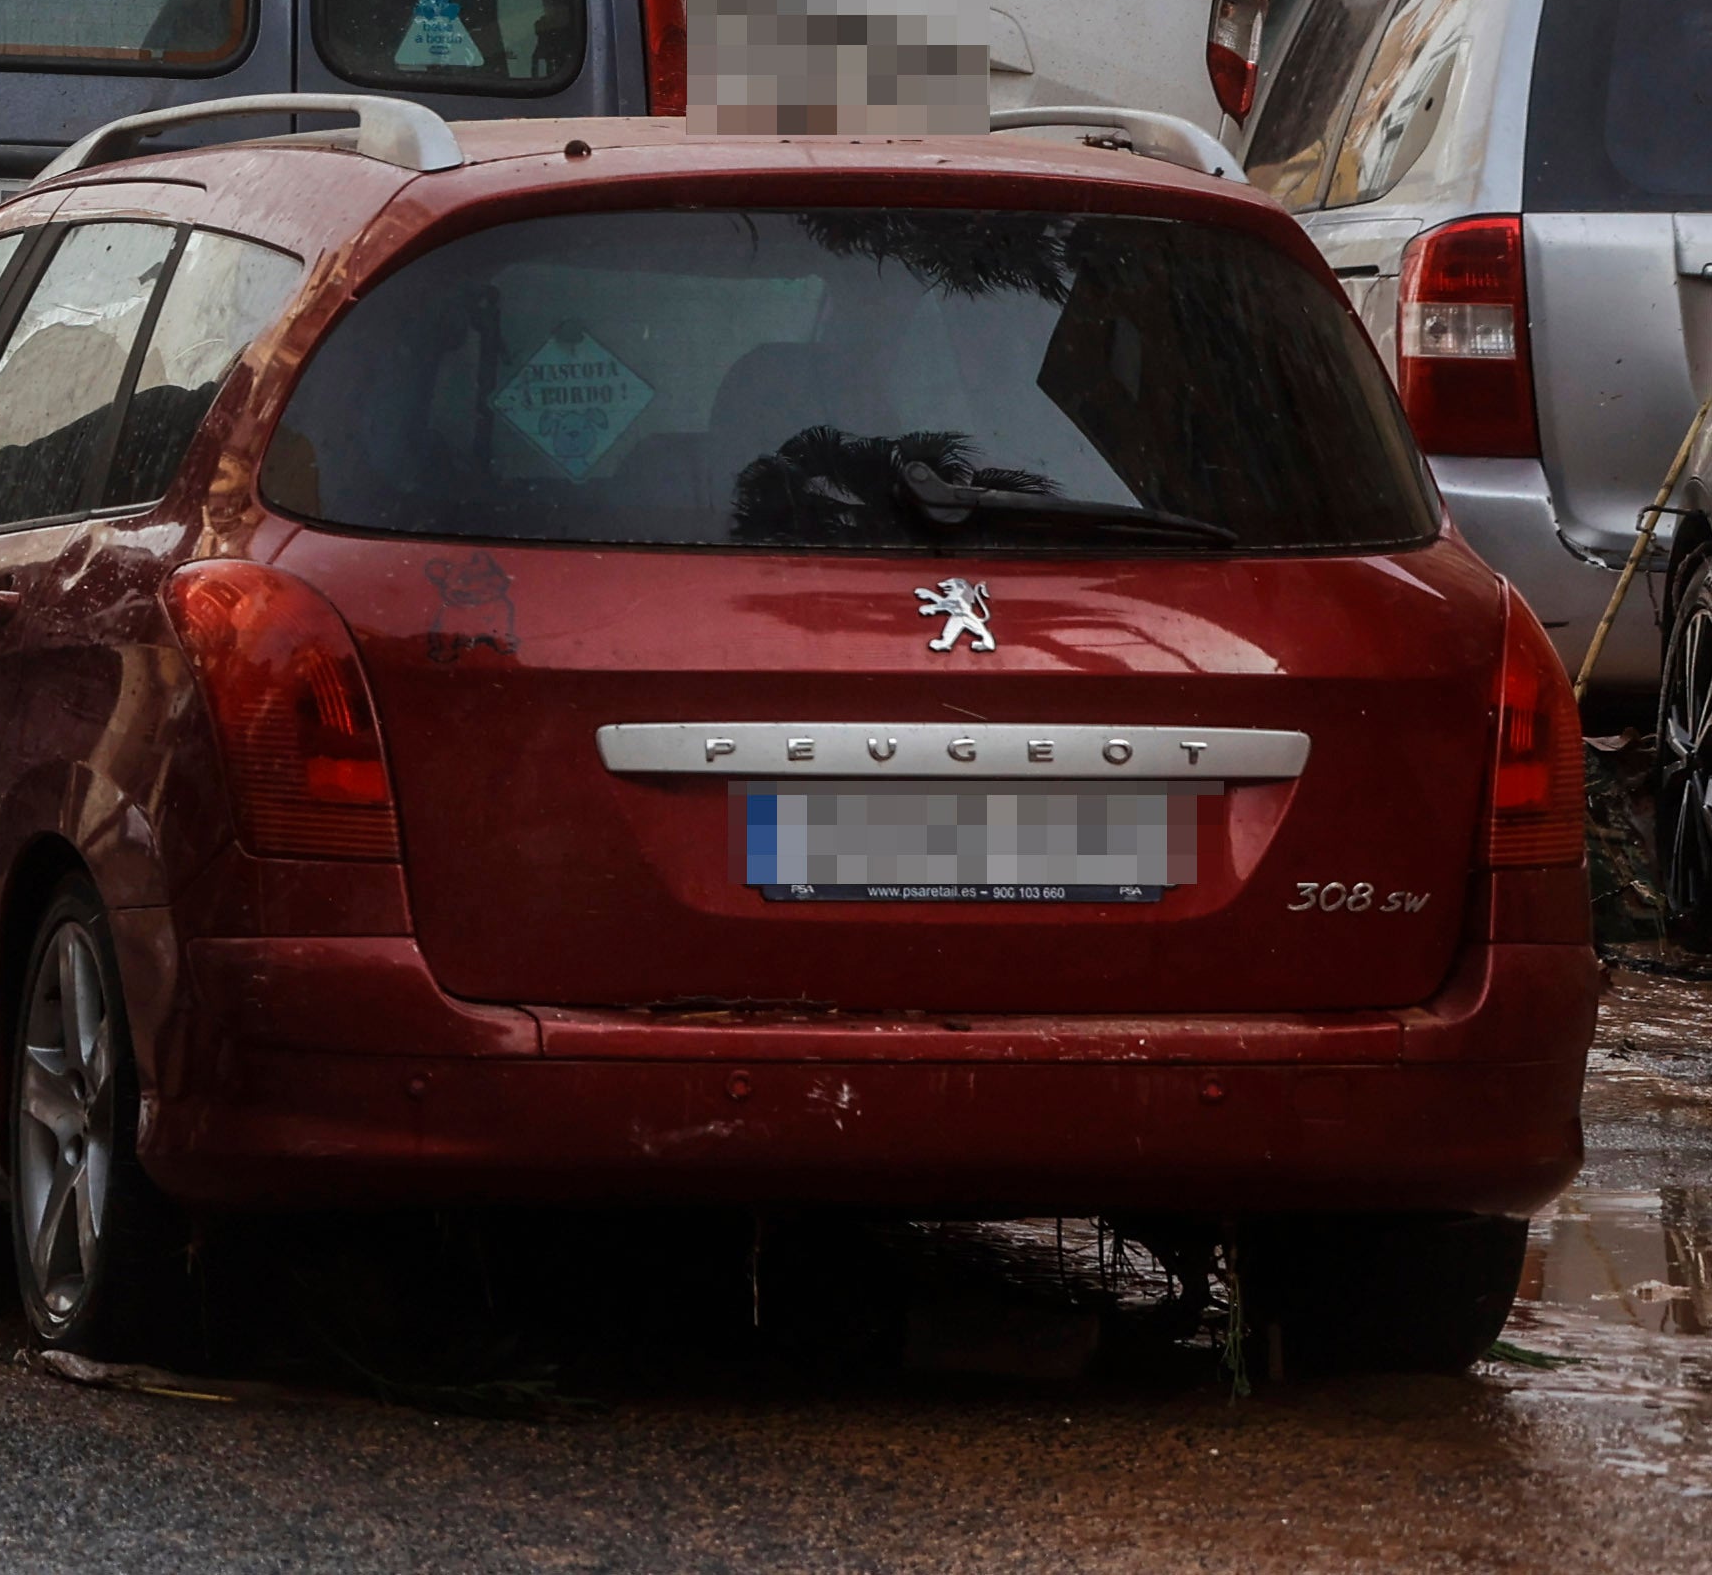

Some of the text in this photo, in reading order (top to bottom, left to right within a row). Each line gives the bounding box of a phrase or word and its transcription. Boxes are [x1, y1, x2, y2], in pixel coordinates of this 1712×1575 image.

[704, 737, 1209, 763] PEUGEOT
[866, 886, 977, 899] www.psaretail.es
[992, 887, 1016, 899] 900
[1020, 887, 1041, 899] 103
[1043, 887, 1066, 899] 660
[1119, 886, 1143, 896] PSA
[1286, 882, 1375, 912] 308
